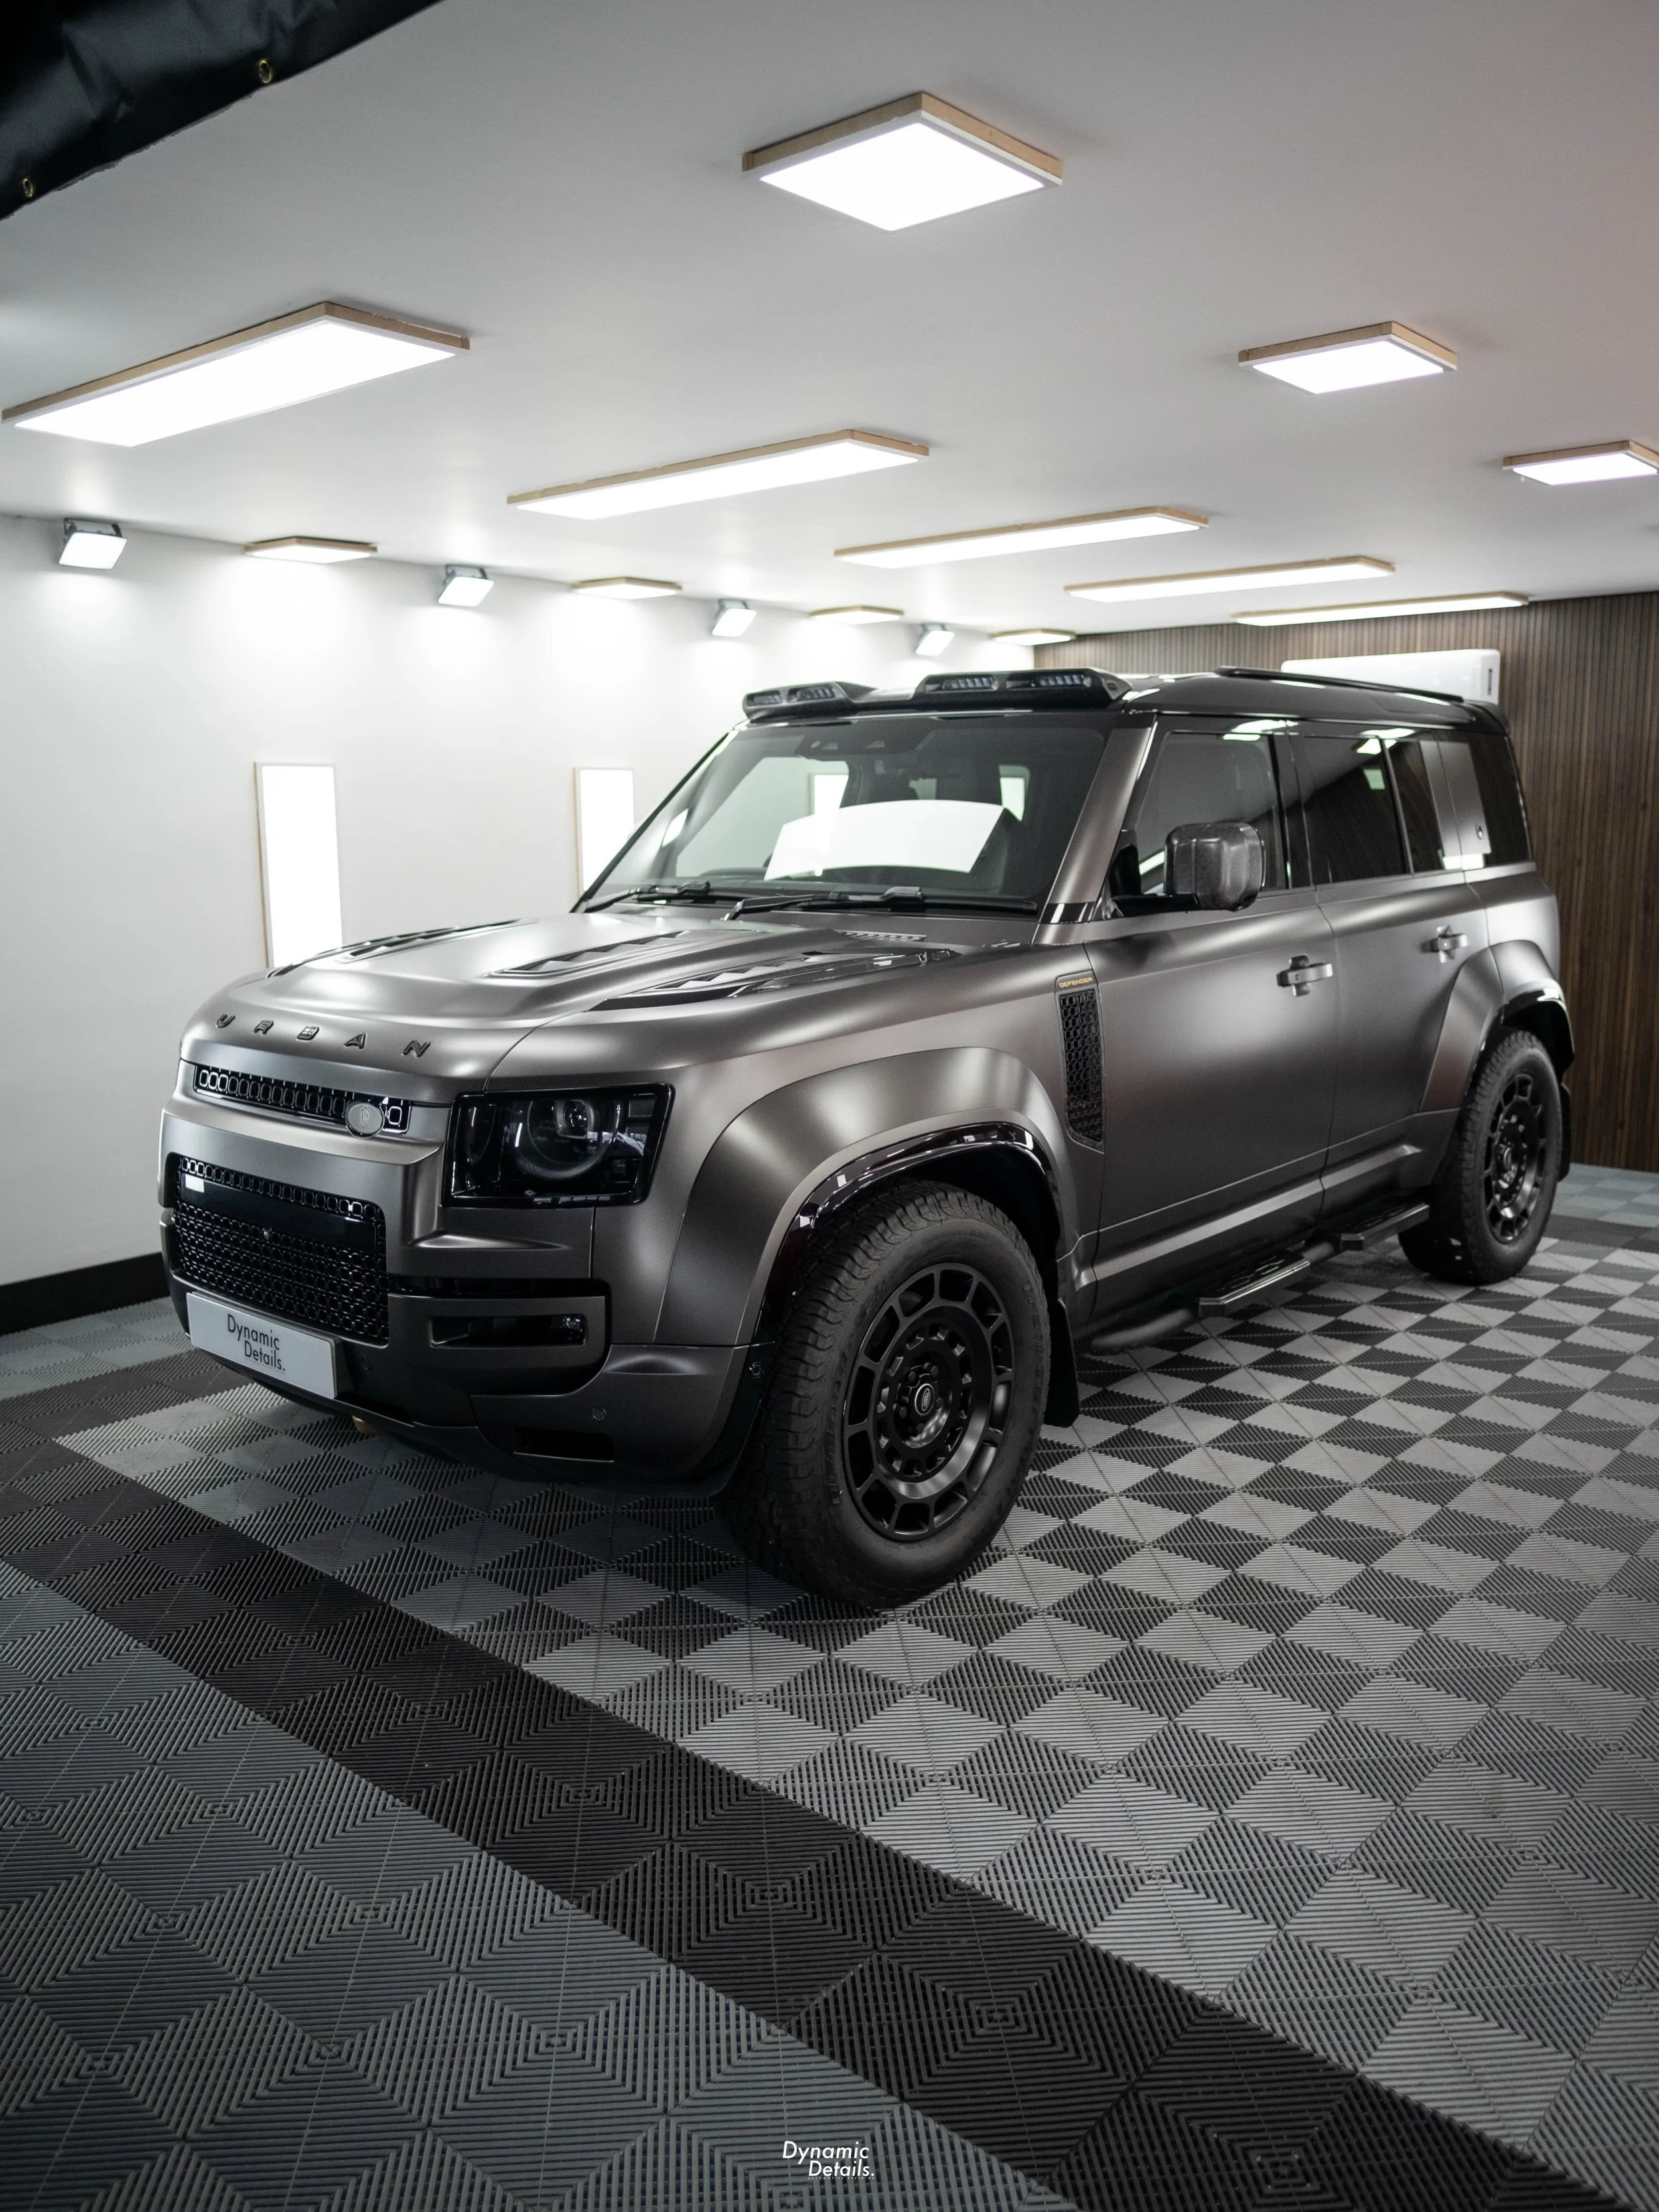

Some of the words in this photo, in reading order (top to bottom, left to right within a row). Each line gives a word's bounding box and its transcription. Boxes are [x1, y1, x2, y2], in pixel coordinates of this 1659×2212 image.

[1058, 976, 1094, 988] DEFENDER
[215, 1013, 431, 1058] URBAN
[227, 1313, 280, 1351] Dynamic
[244, 1340, 285, 1371] Details.
